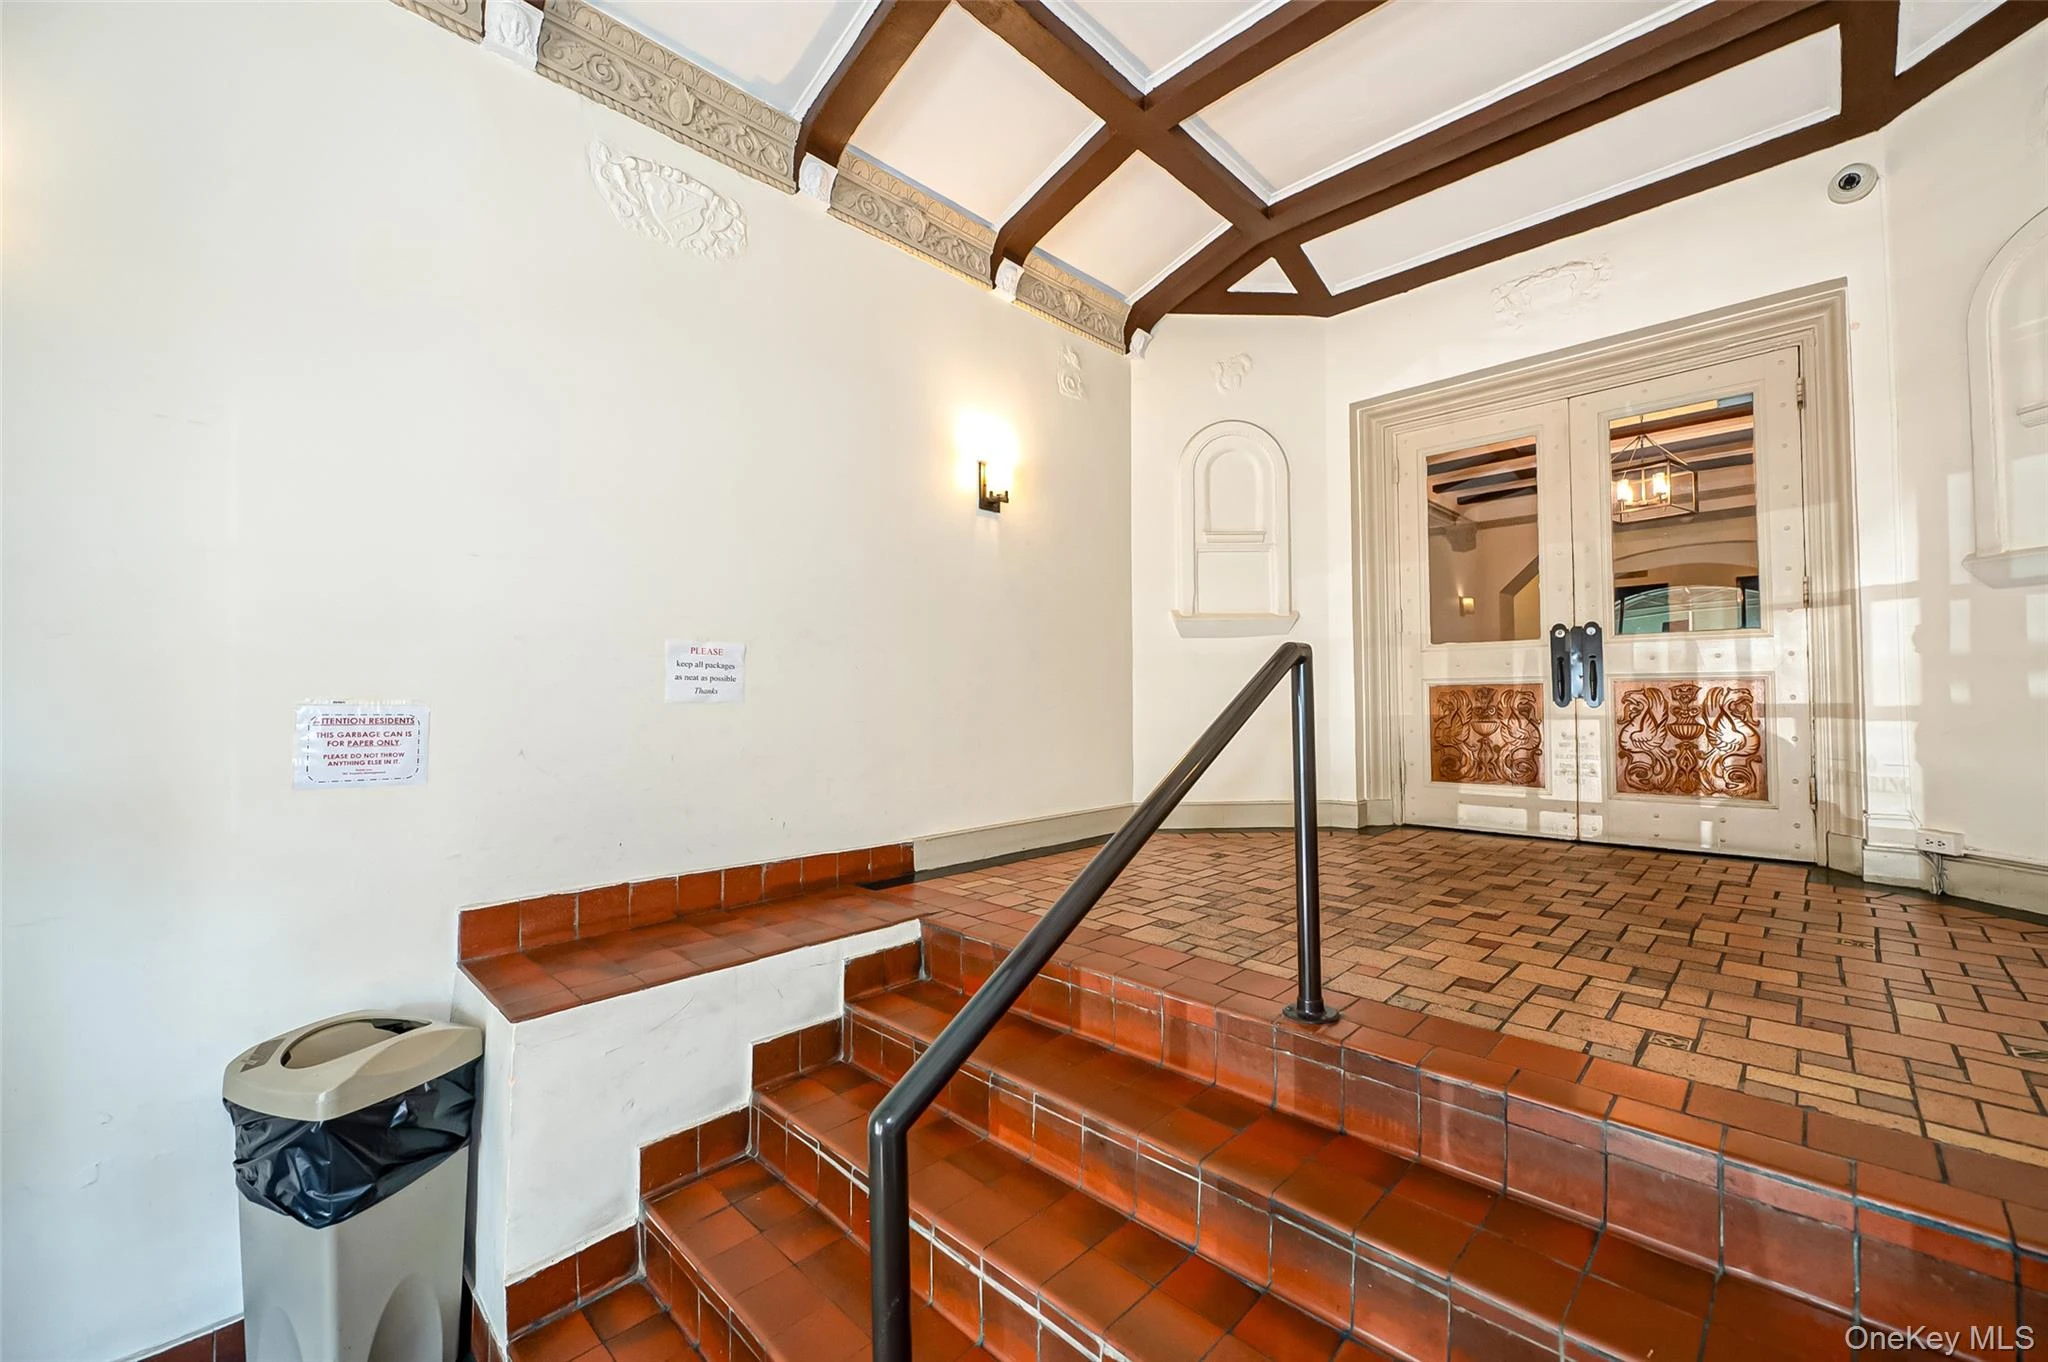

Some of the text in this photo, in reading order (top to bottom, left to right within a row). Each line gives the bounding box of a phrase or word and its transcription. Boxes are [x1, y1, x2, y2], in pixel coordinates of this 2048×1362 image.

[690, 646, 724, 656] PLEASE
[676, 660, 693, 669] keep
[705, 662, 735, 671] packages
[709, 675, 737, 683] possible
[694, 687, 718, 695] Thanks
[369, 717, 415, 725] RESIDENTS
